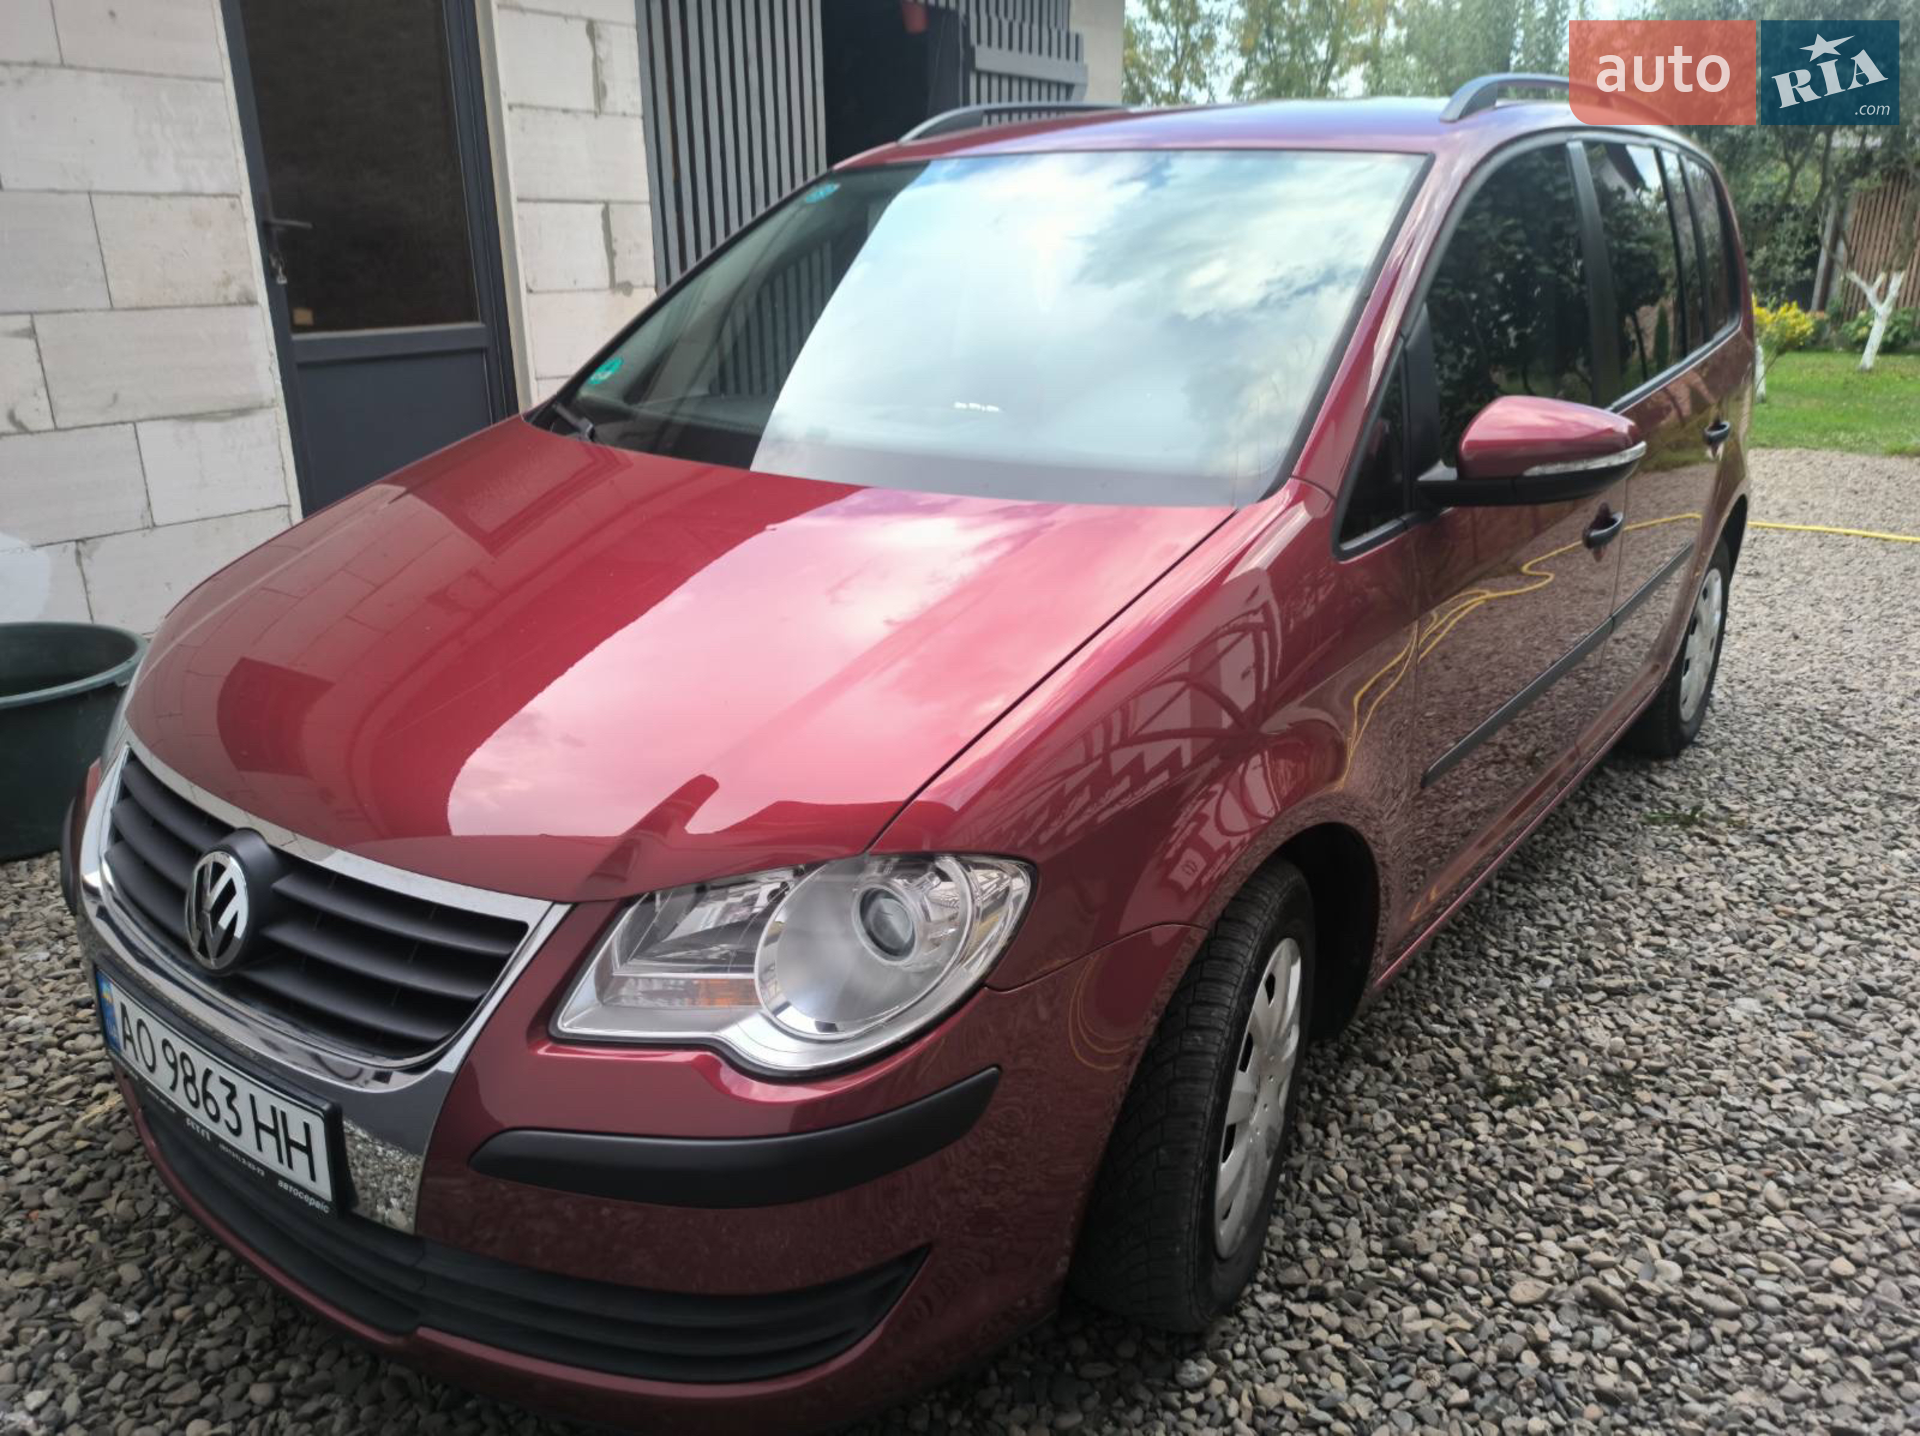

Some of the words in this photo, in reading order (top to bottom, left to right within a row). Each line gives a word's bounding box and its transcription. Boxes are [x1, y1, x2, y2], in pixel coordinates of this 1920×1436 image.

[120, 1002, 157, 1074] AO
[161, 1037, 242, 1137] 9863
[249, 1092, 317, 1183] HH
